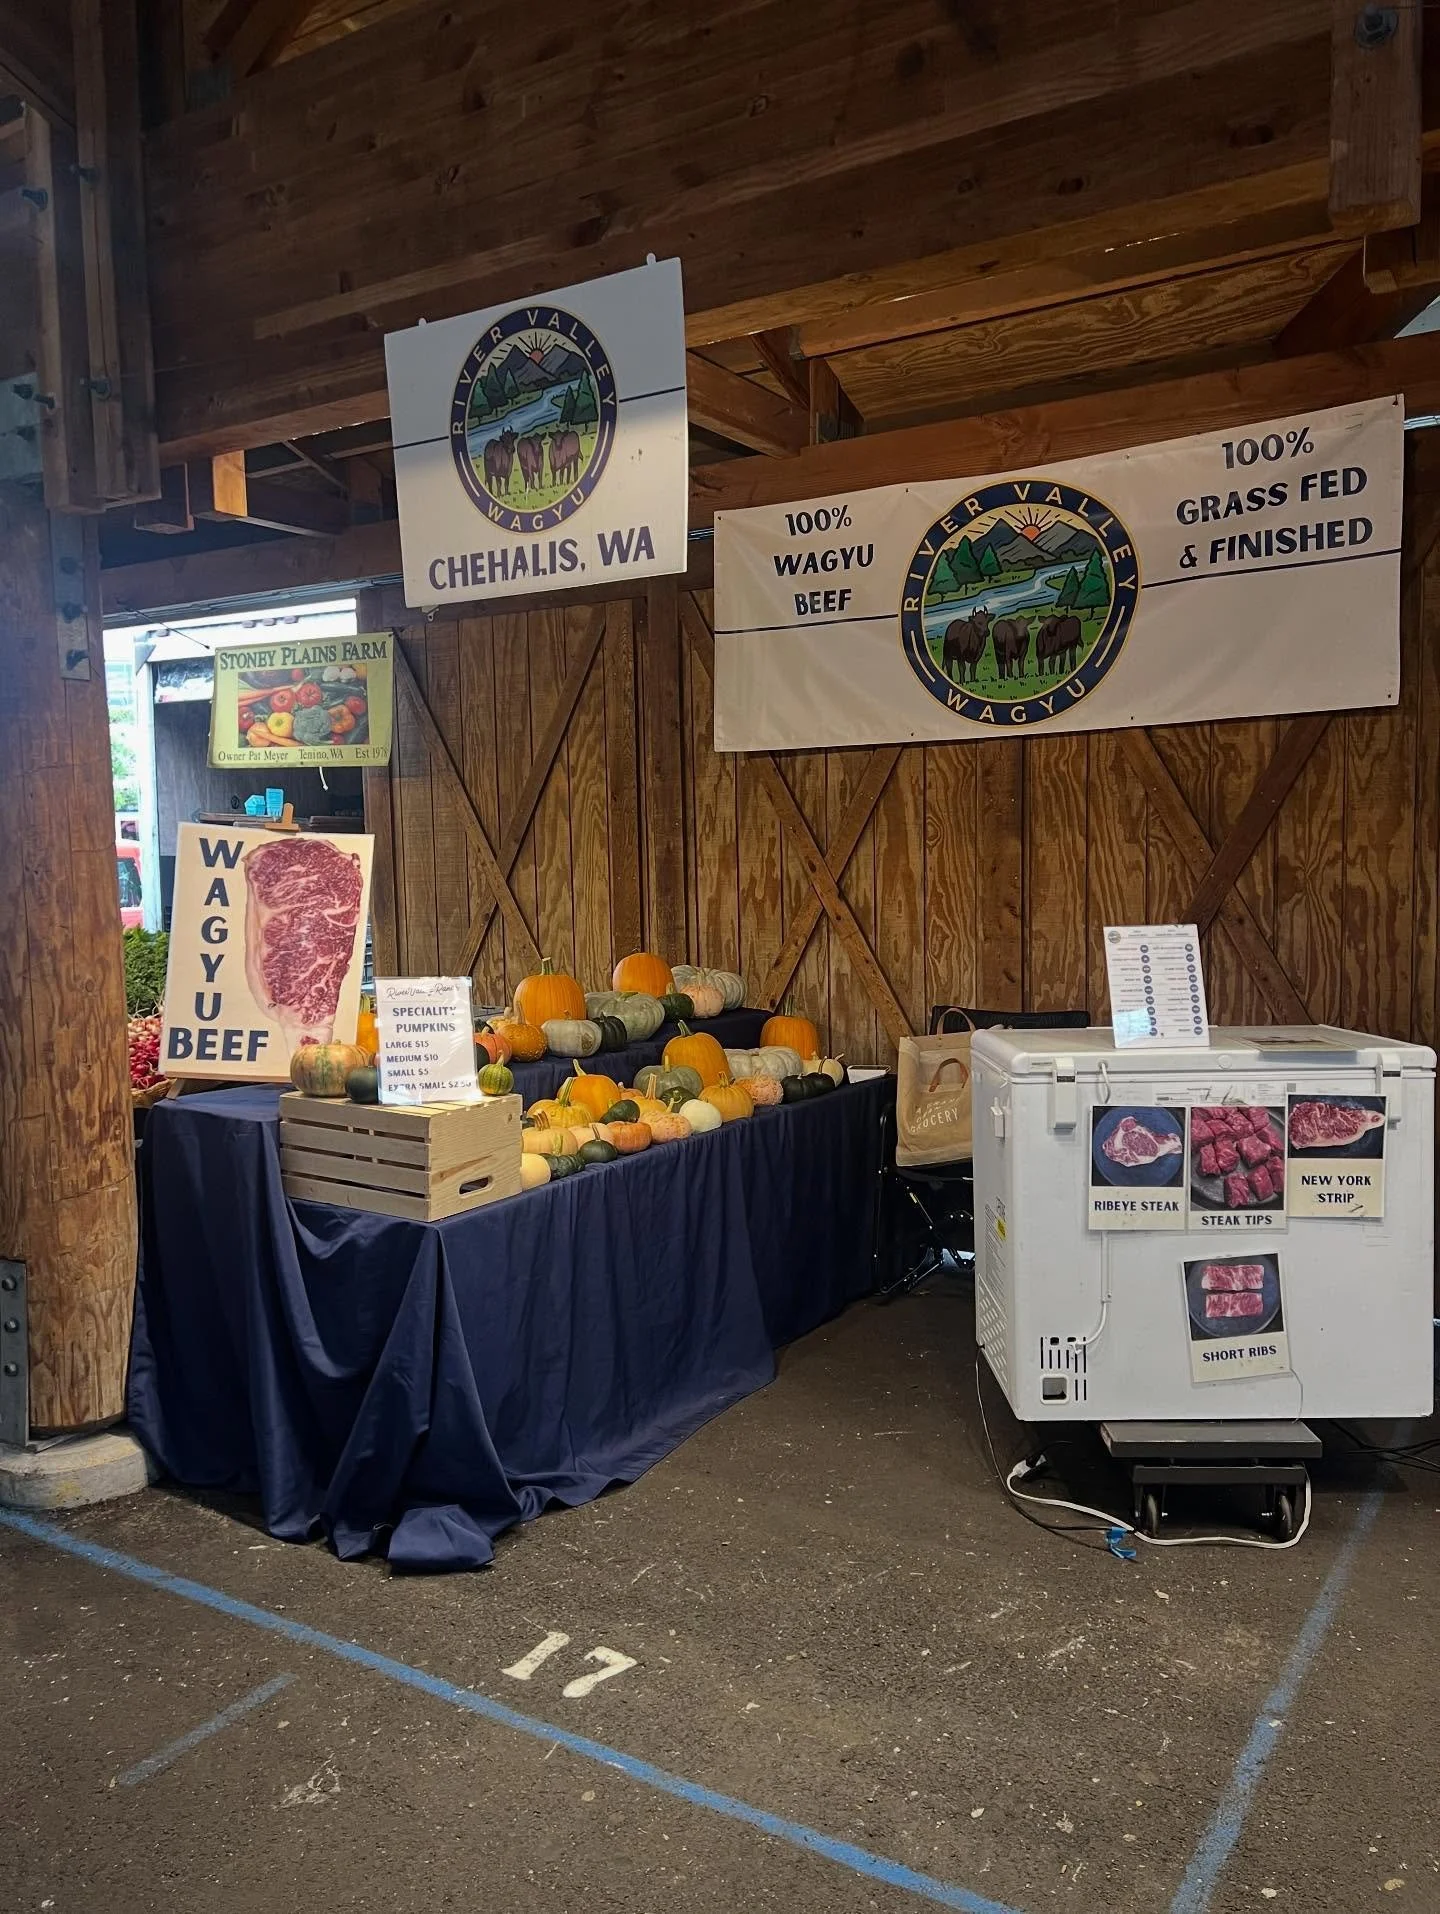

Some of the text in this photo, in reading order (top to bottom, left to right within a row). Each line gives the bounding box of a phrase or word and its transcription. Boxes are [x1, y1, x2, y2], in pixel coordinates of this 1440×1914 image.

[453, 310, 615, 435] RIVER VALLEY
[1222, 427, 1315, 470] 100%
[488, 488, 584, 531] WAGYU
[1176, 466, 1368, 525] GRASS FED
[785, 505, 853, 536] 100%
[429, 526, 655, 590] CHEHALIS, WA
[904, 483, 1136, 613] RIVER VALLEY
[1180, 517, 1374, 569] & FINISHED
[774, 543, 875, 577] WAGYU
[794, 588, 852, 616] BEEF
[220, 641, 387, 670] STONEY PLAINS FARM
[947, 677, 1086, 723] WAGYU
[218, 750, 289, 763] Owner Pat Meyer
[355, 748, 369, 759] Est
[194, 838, 244, 1022] WAGYU
[396, 1022, 456, 1034] PUMPKINS
[168, 1027, 269, 1062] BEEF
[386, 1041, 412, 1049] LARGE
[386, 1054, 422, 1063] MEDIUM
[388, 1068, 415, 1077] SMALL
[1301, 1175, 1371, 1186] NEW YORK
[1094, 1200, 1179, 1212] RIBEYE STEAK
[1318, 1193, 1354, 1203] STRIP
[1201, 1215, 1273, 1226] STEAK TIPS
[1202, 1345, 1277, 1362] SHORT RIBS
[501, 1631, 637, 1697] 17
